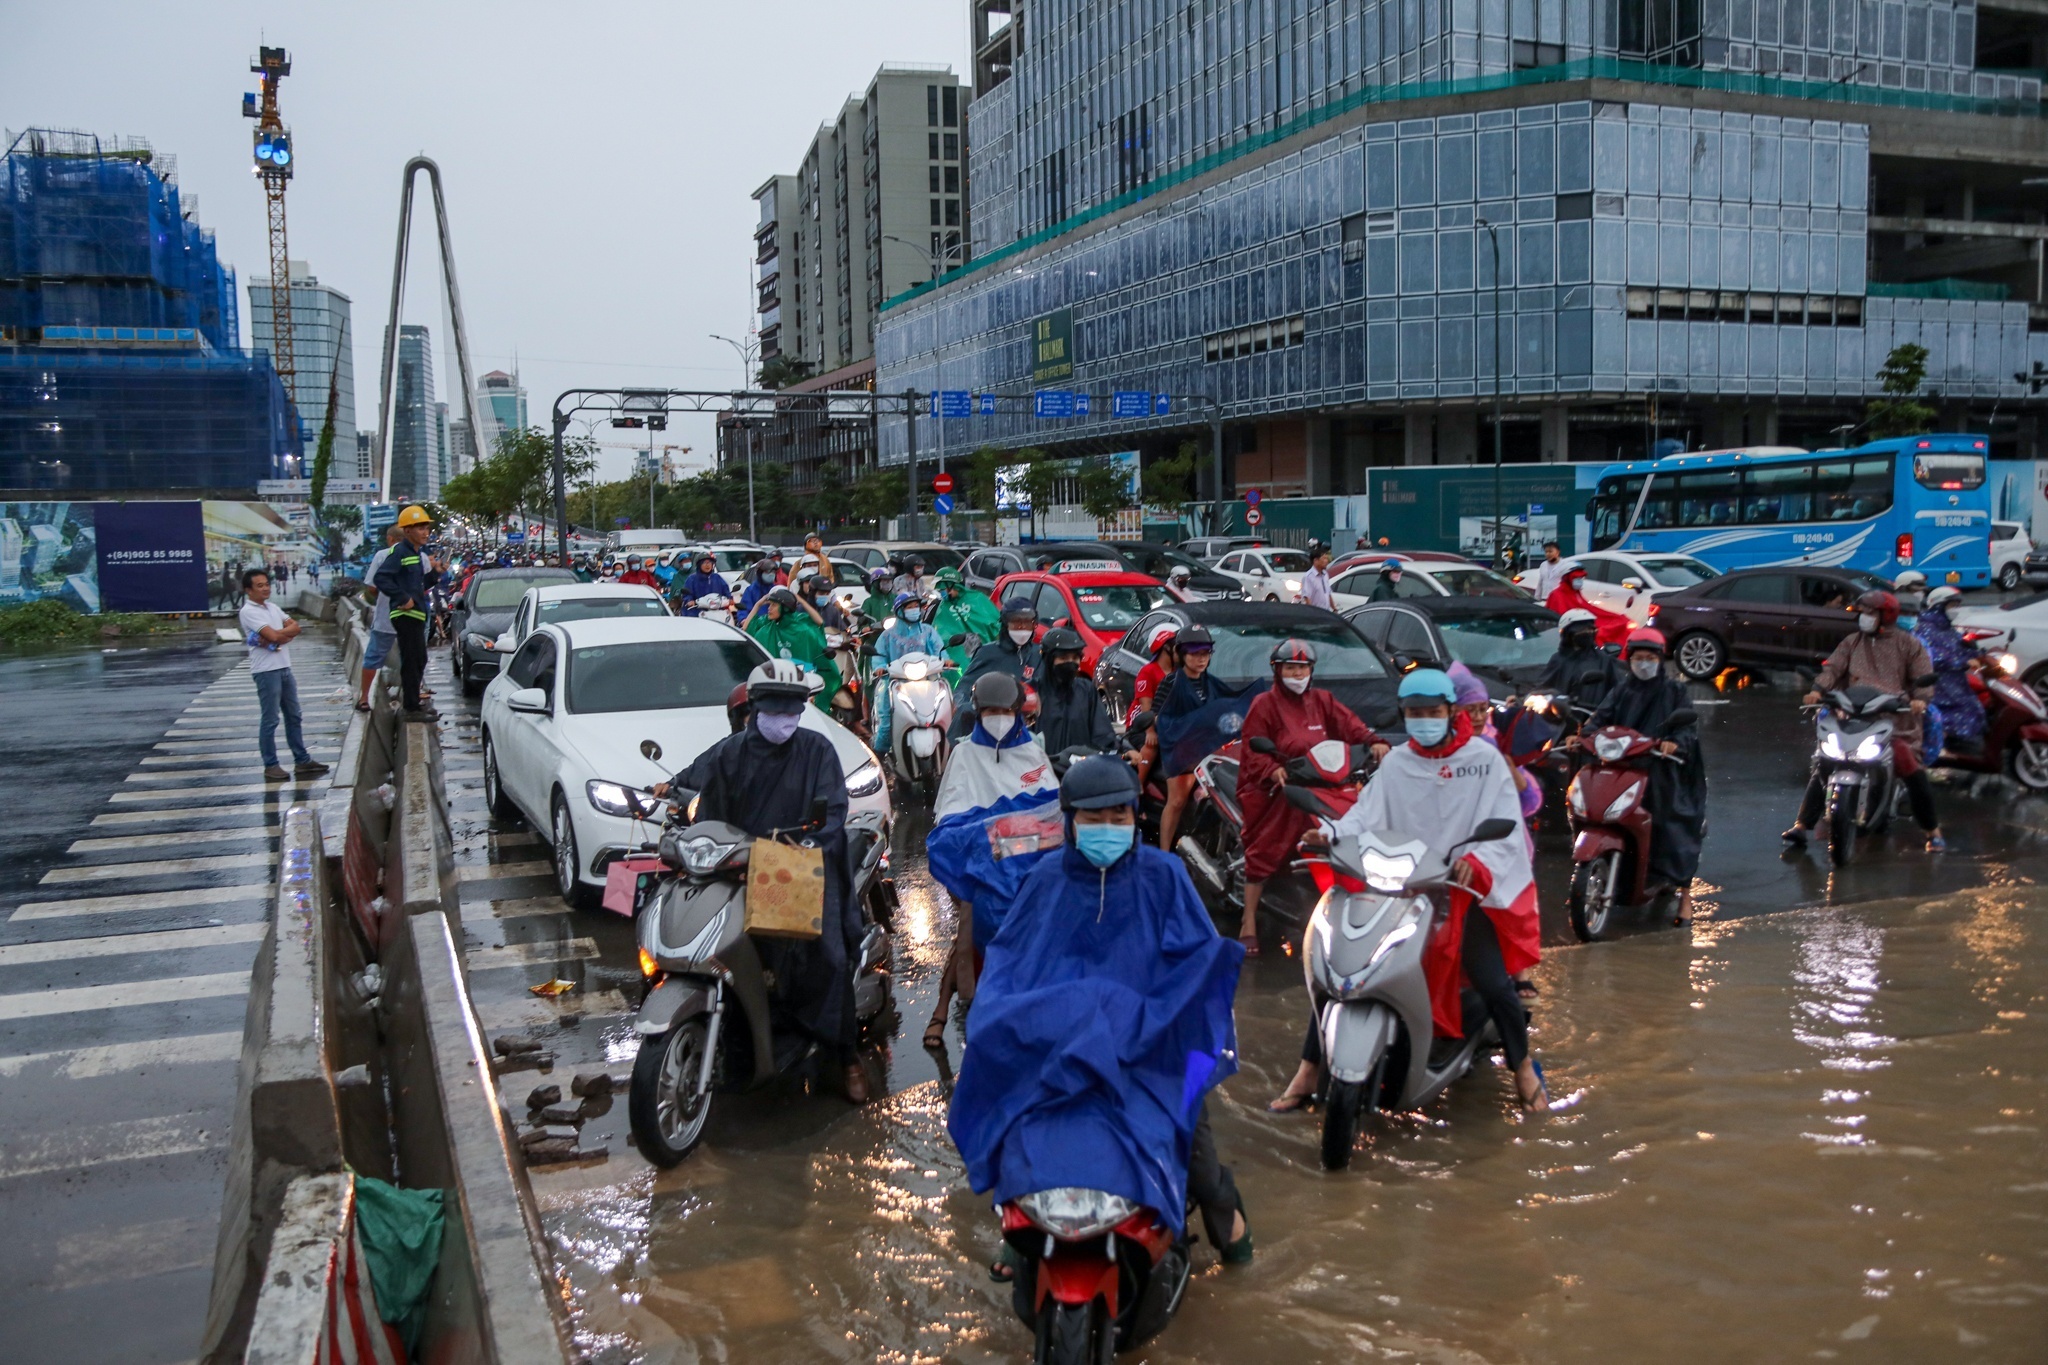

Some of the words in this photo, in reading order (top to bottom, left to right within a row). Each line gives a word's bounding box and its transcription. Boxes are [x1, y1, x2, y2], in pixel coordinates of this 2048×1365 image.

[1042, 319, 1050, 339] THE
[1042, 337, 1065, 361] HALLMARK
[1531, 484, 1554, 493] Grade
[106, 550, 151, 560] +(84)905
[153, 550, 166, 558] 85
[168, 549, 193, 558] 9988
[1456, 764, 1490, 779] DOJI
